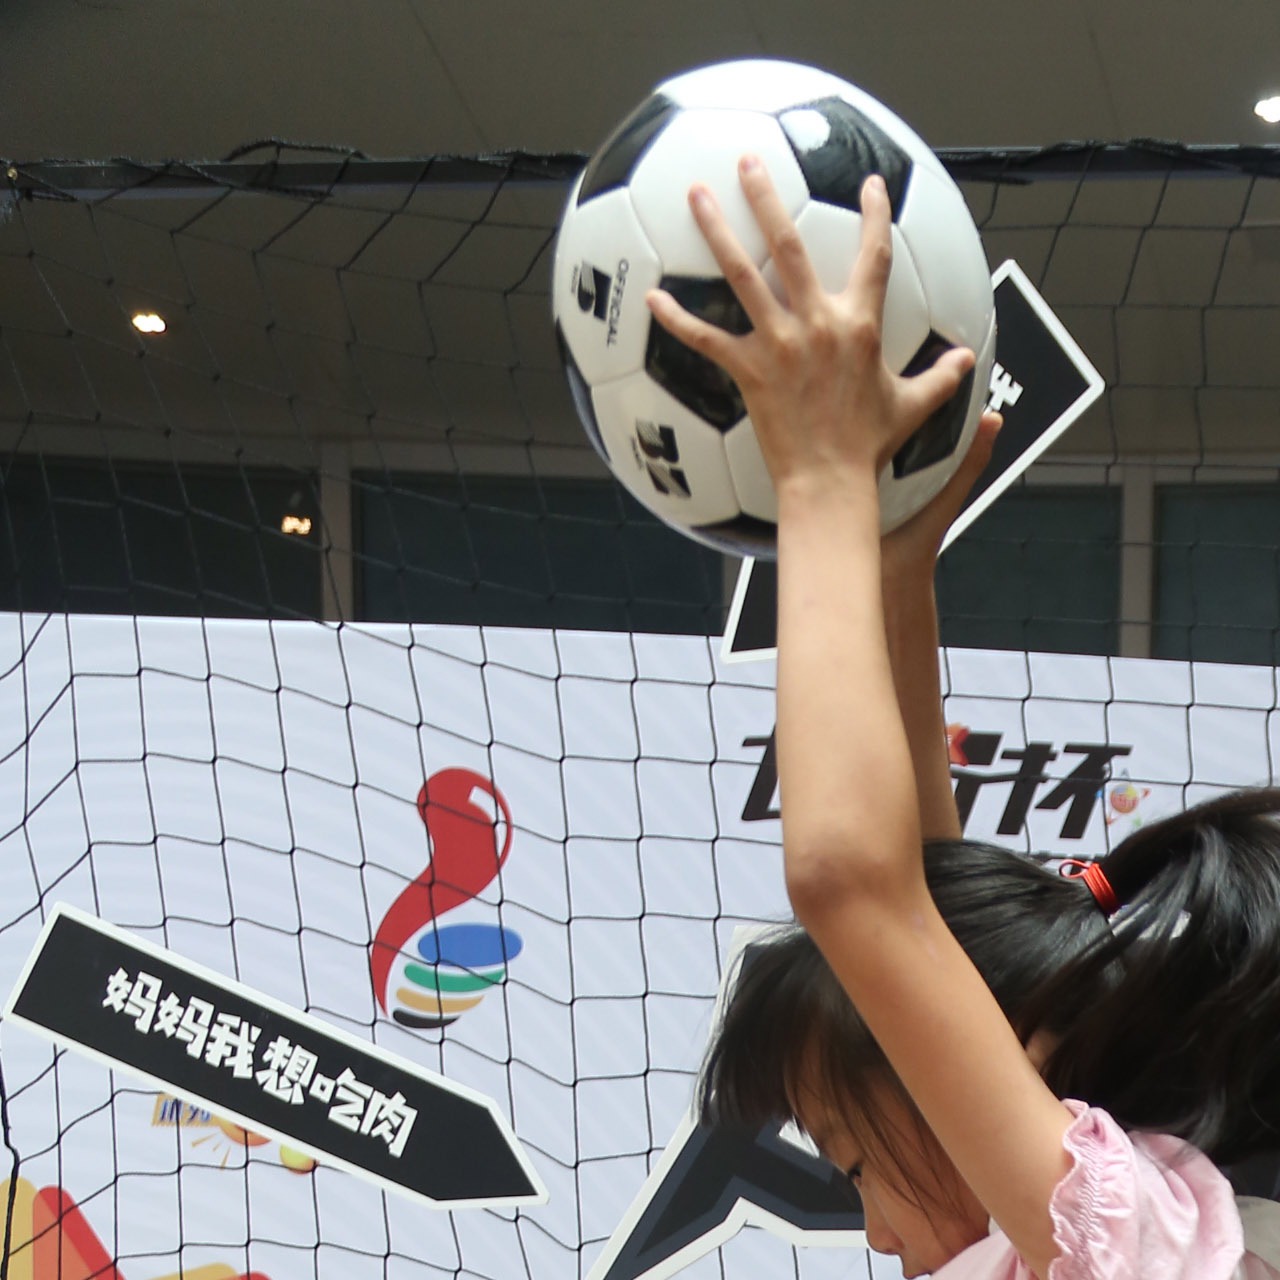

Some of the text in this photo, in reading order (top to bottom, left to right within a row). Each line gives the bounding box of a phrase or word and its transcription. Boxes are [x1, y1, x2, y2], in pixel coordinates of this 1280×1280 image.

[607, 258, 629, 348] OFFICIAL
[103, 967, 417, 1159] 妈妈我想吃肉
